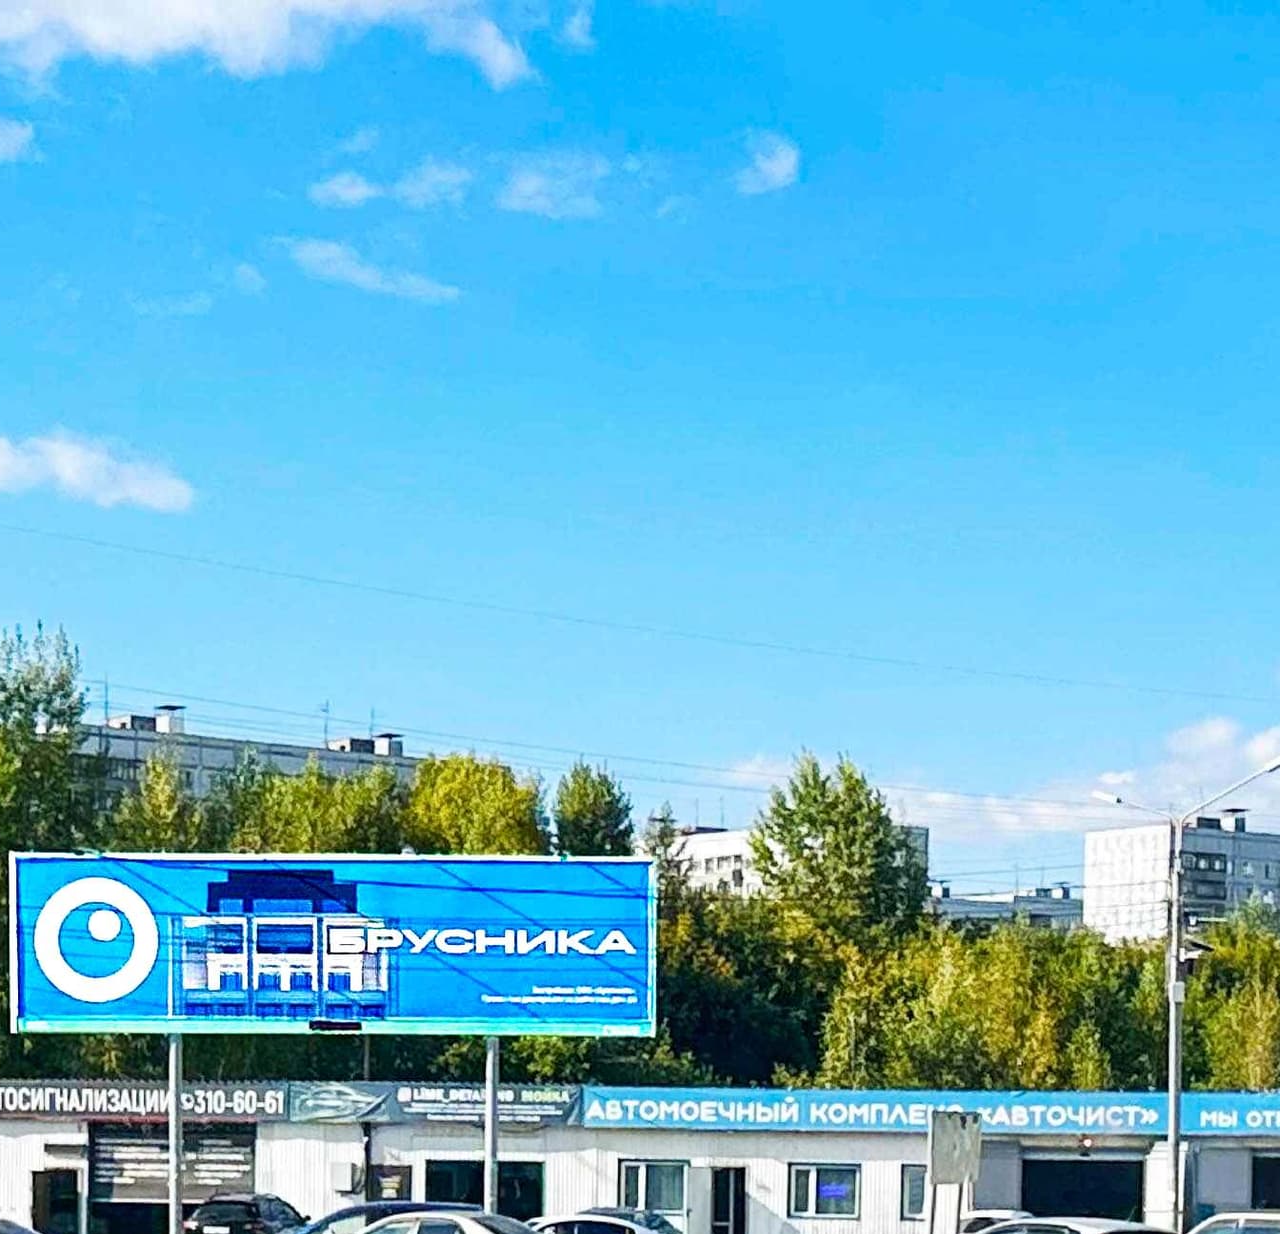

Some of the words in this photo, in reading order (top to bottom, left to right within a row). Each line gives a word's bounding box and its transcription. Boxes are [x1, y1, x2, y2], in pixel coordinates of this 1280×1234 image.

[327, 928, 638, 955] БРУСНИКА
[193, 1089, 285, 1114] 310-60-61
[585, 1096, 799, 1123] АВТОМОЕЧНЫЙ
[1199, 1110, 1237, 1129] МЫ
